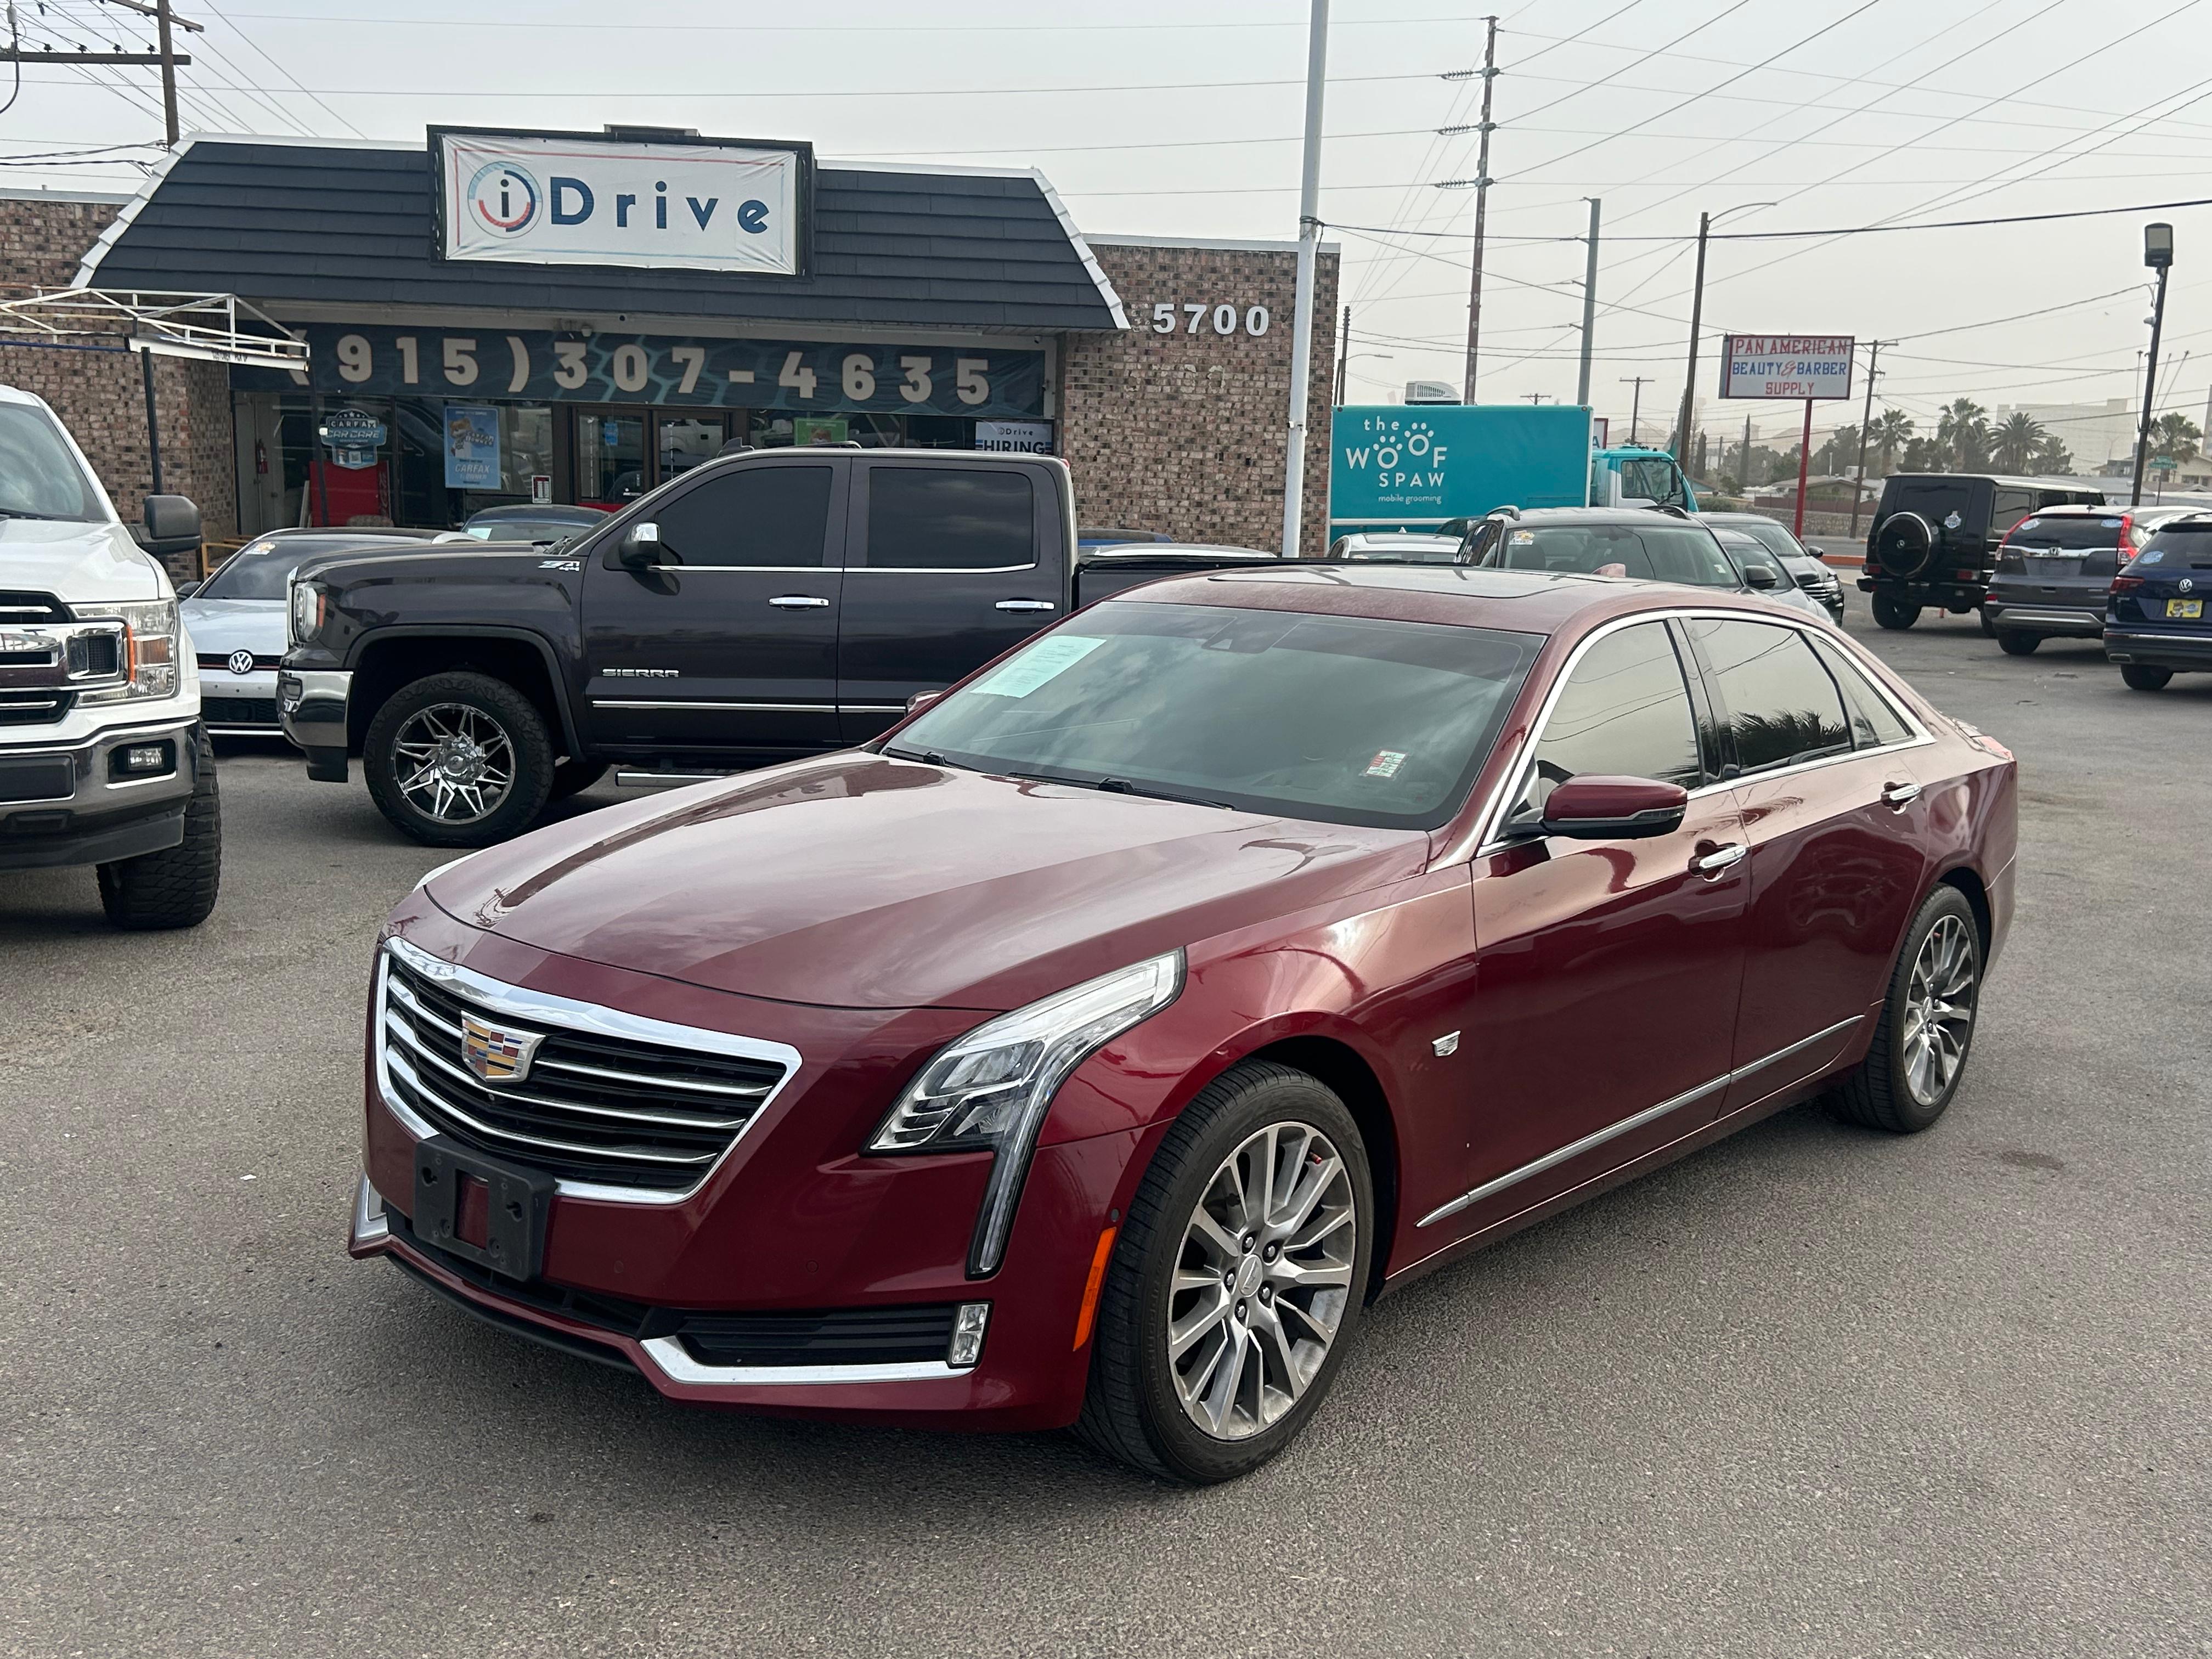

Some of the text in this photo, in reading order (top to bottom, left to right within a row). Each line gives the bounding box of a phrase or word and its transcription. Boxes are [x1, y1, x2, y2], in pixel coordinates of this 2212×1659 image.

[1153, 303, 1269, 337] 5700
[1735, 338, 1848, 355] PAN AMERICAN
[1732, 362, 1783, 375] BEAUTY
[1797, 362, 1847, 375] BARBER
[1765, 382, 1815, 395] SUPPLY
[330, 420, 376, 428] CARFAX
[1363, 416, 1400, 431] the
[350, 430, 380, 439] CARE
[984, 439, 1046, 454] HIRING
[1345, 432, 1448, 470] WOOF
[455, 464, 490, 473] CARFAX
[1379, 472, 1445, 488] SPAW
[1378, 494, 1442, 505] mobile grooming
[602, 668, 679, 678] SIERRA
